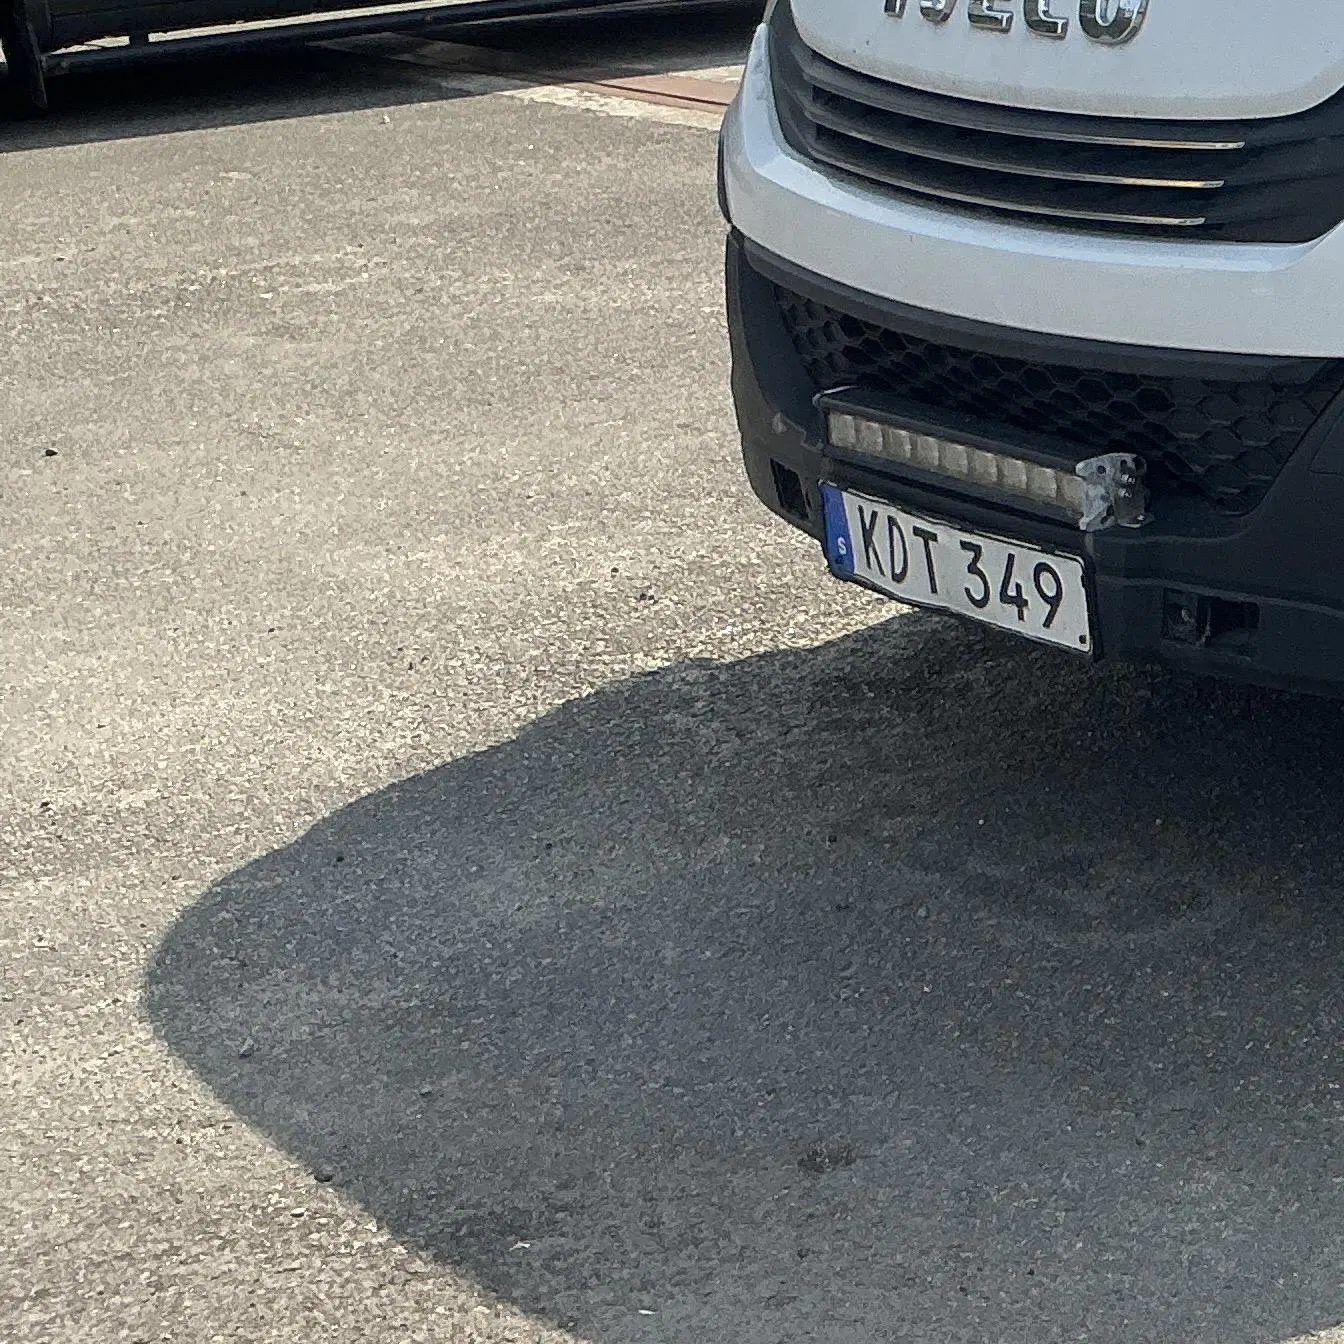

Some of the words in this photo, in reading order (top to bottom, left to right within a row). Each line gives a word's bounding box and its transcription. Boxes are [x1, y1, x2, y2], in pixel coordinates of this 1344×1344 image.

[837, 536, 847, 555] S
[857, 504, 939, 594] KDT
[959, 539, 1063, 629] 349
